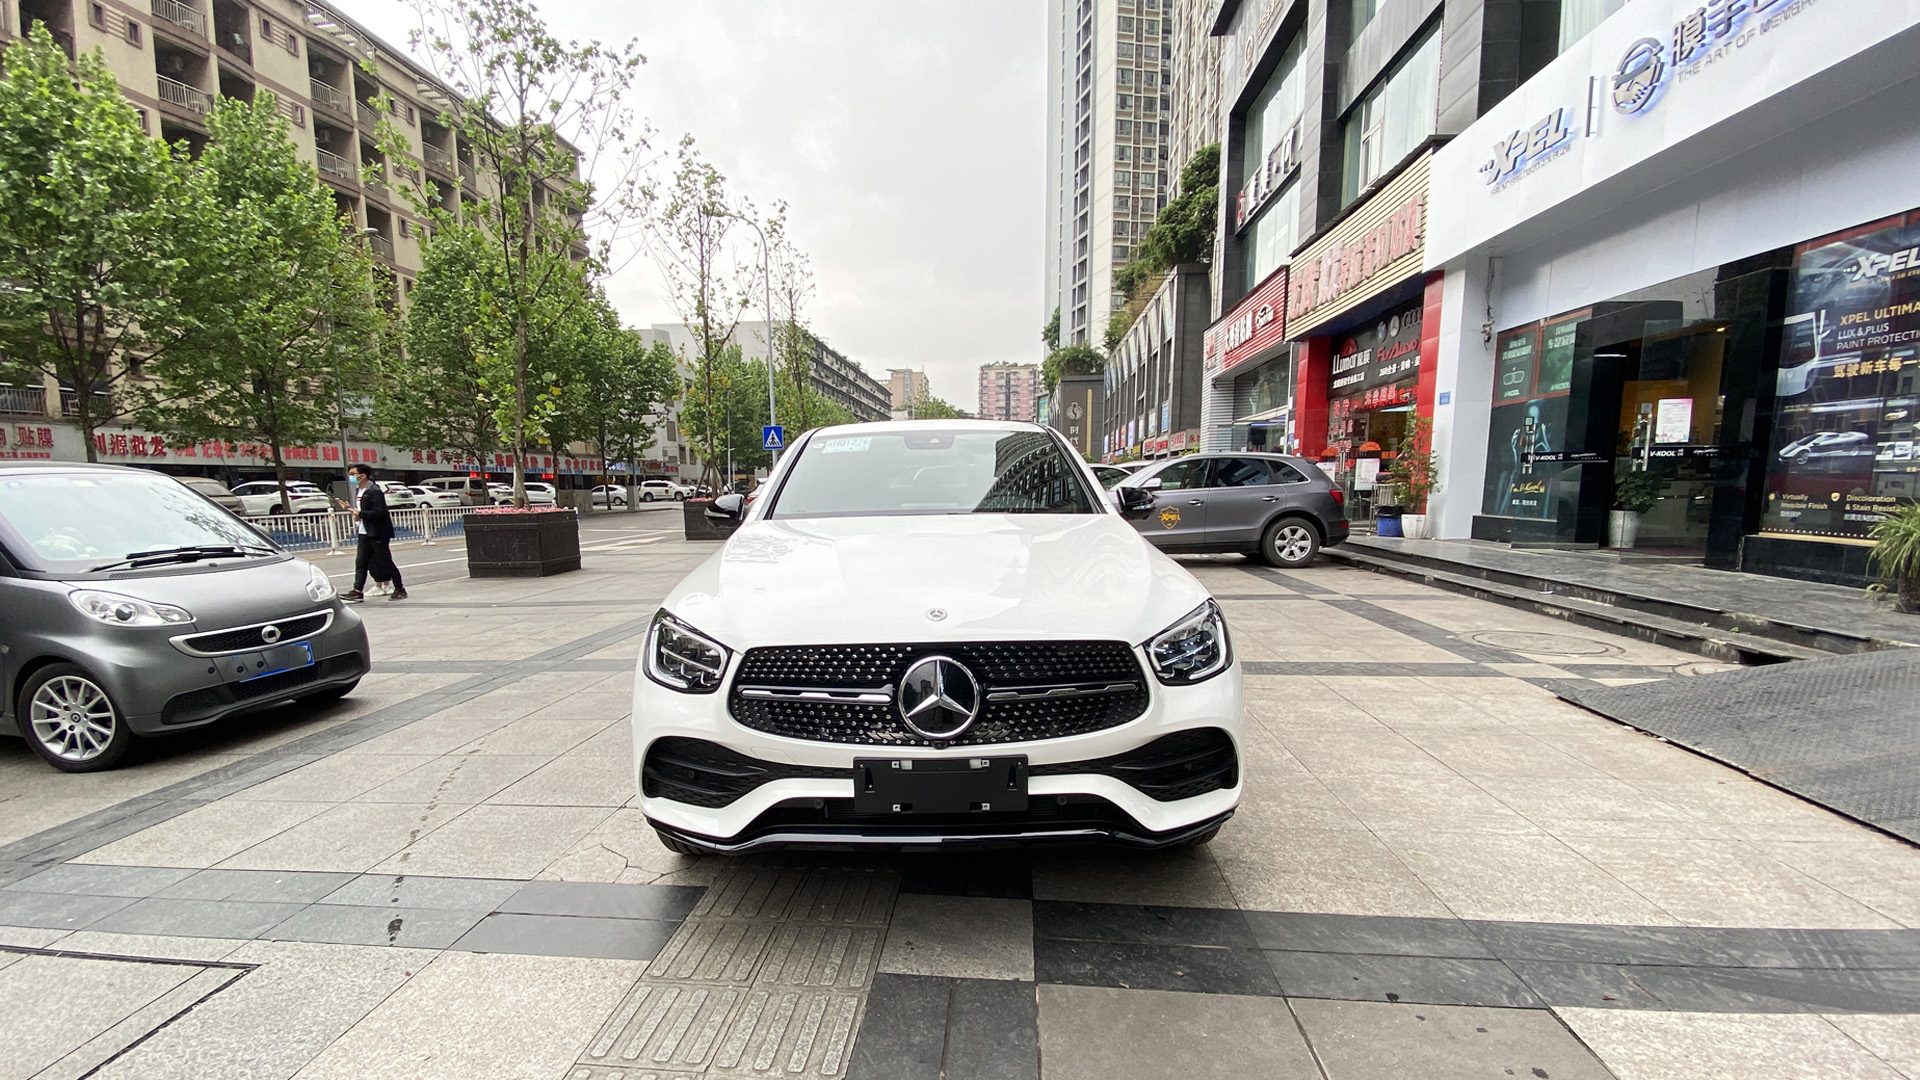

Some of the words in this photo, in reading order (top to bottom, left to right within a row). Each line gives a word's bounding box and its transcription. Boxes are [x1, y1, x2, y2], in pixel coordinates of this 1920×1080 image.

[1678, 61, 1701, 84] THE
[1704, 41, 1732, 67] ART
[1736, 28, 1756, 48] OF
[1486, 108, 1568, 185] XPEL
[1851, 247, 1920, 281] XPEL
[1840, 311, 1870, 326] XPEL
[1874, 300, 1920, 320] ULTIMA
[1837, 338, 1865, 350] PAINT
[1867, 329, 1920, 346] PROTECTI
[1838, 328, 1856, 340] LUX
[1865, 322, 1890, 337] PLUS
[1833, 357, 1920, 378] 驾驶新车每一
[17, 426, 55, 449] 贴膜
[1782, 493, 1808, 501] Virtually
[1846, 494, 1896, 502] Discoloration
